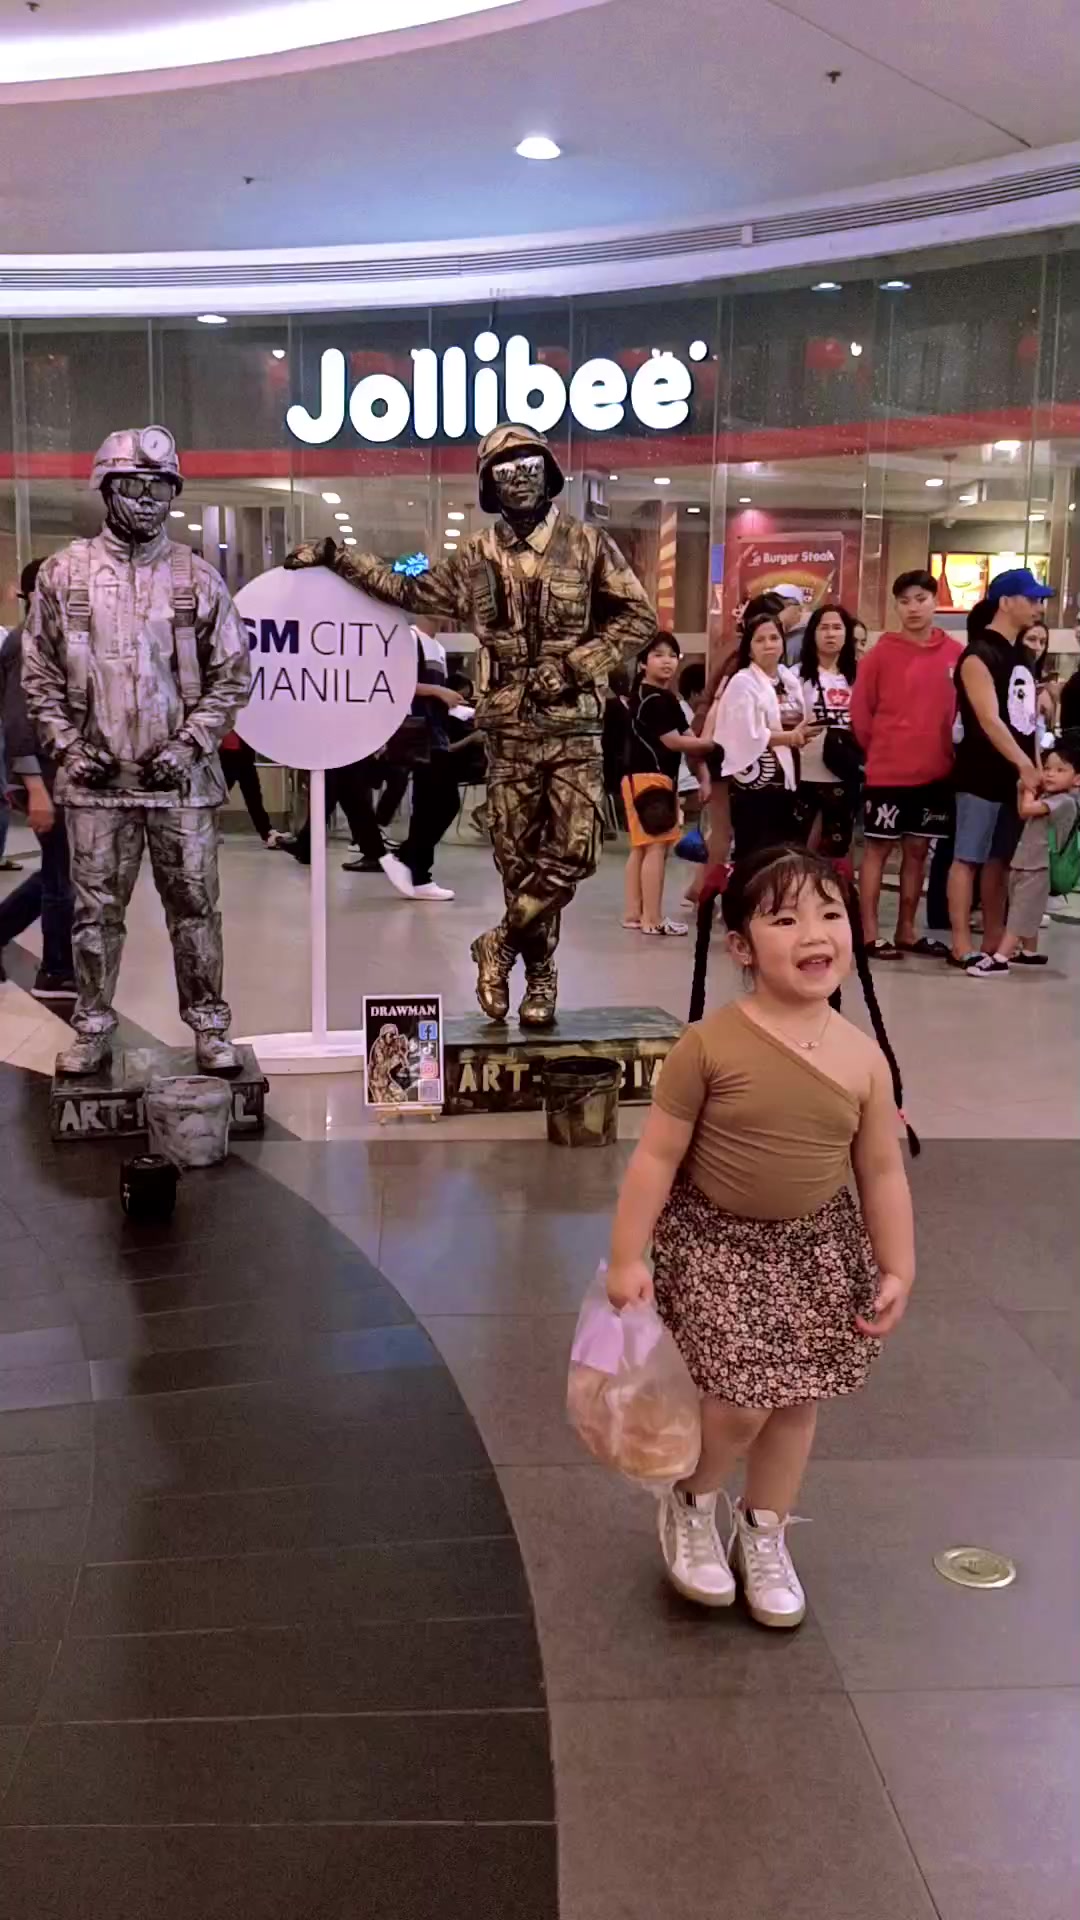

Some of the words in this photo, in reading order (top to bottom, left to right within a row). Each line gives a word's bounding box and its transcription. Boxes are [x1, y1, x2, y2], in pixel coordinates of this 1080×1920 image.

[286, 331, 692, 444] Jollibee
[763, 551, 799, 565] Burger
[801, 549, 835, 562] Steak
[310, 621, 399, 658] CITY
[874, 803, 900, 829] NY
[370, 1005, 437, 1017] DRAWMAN
